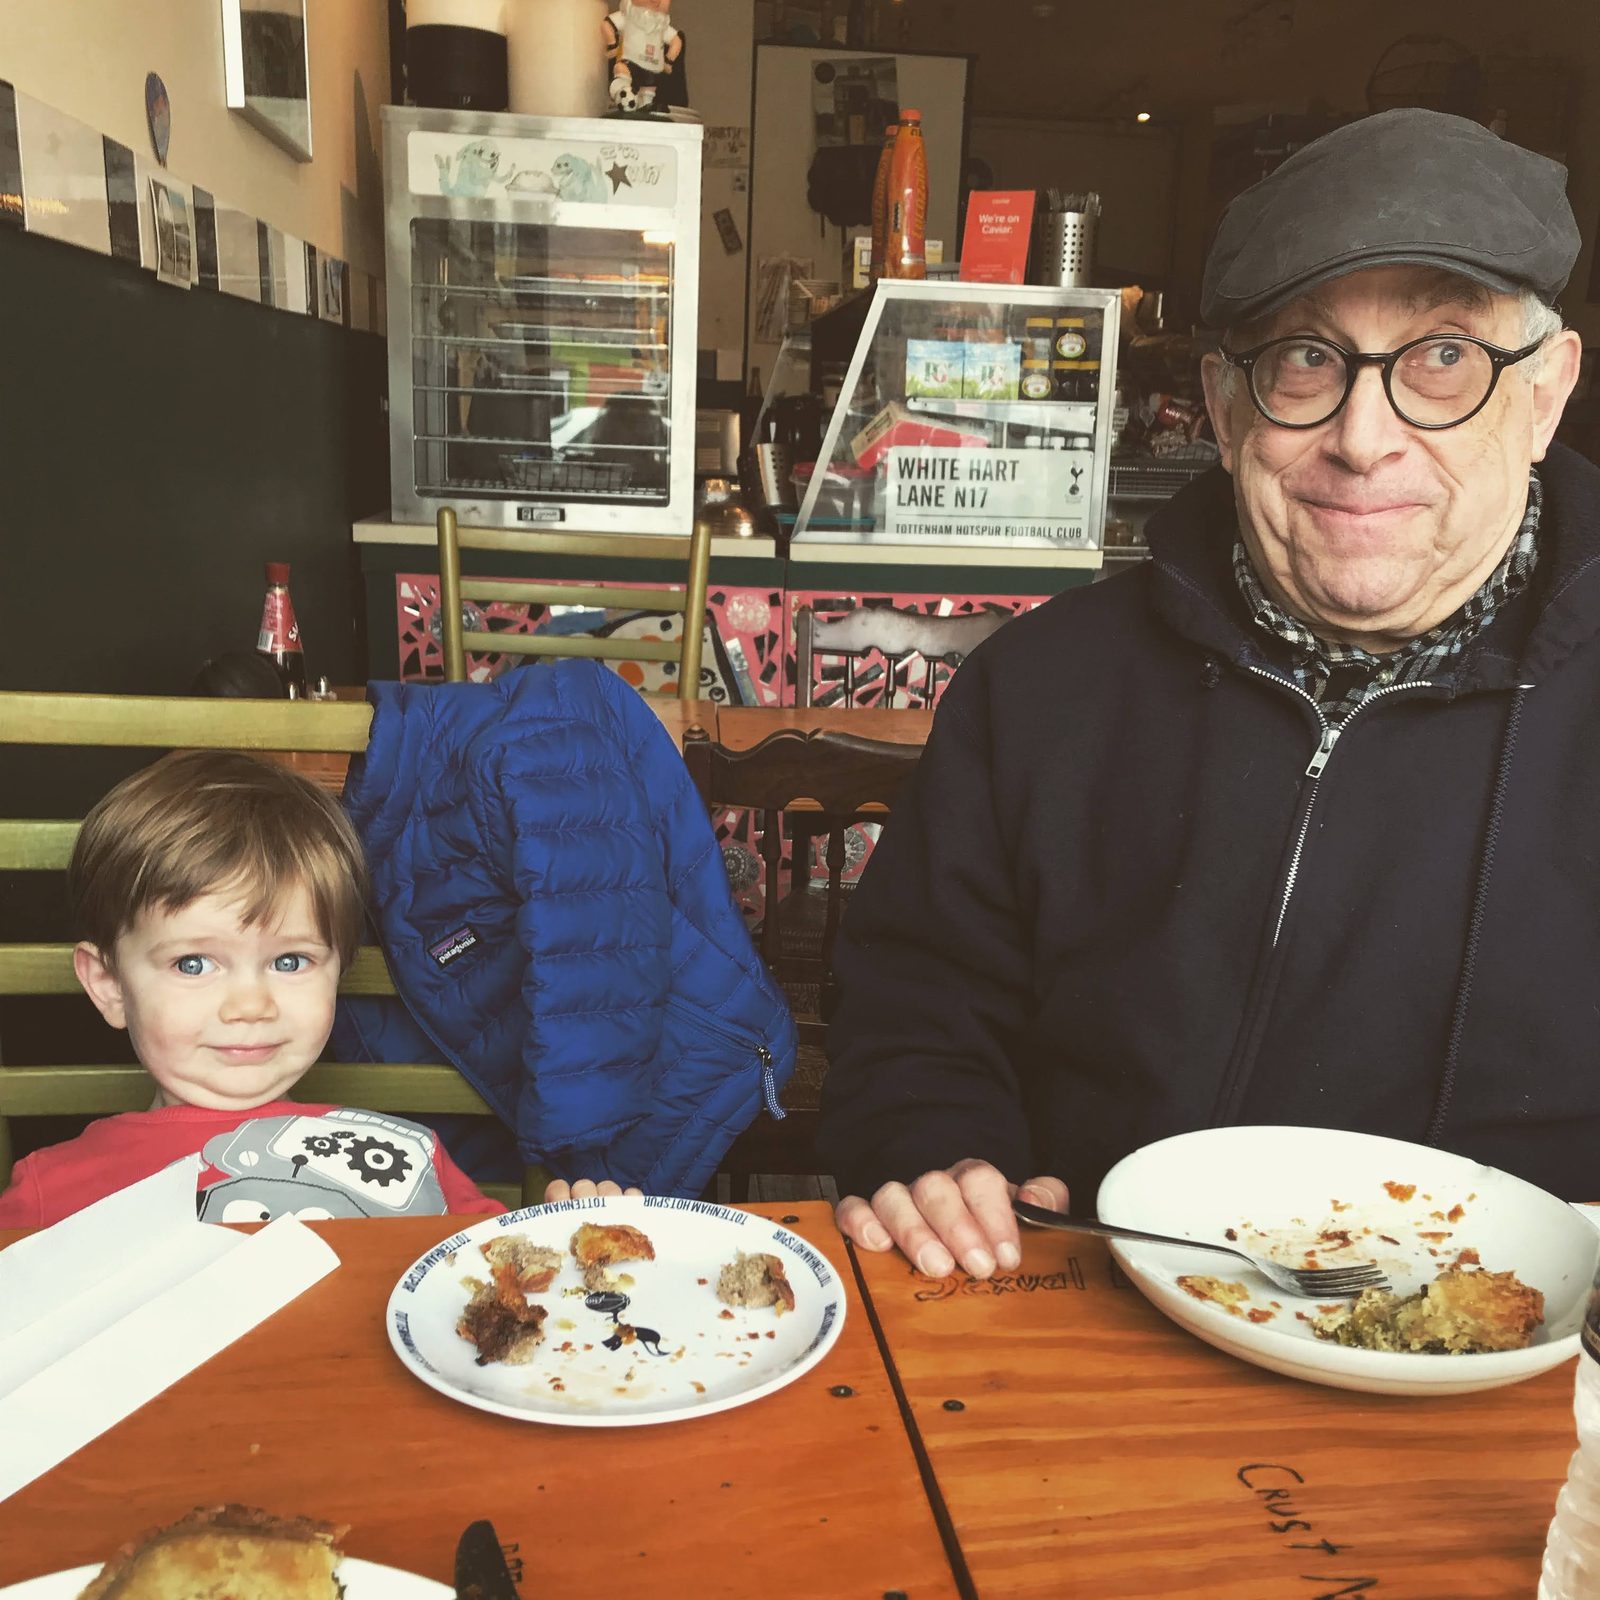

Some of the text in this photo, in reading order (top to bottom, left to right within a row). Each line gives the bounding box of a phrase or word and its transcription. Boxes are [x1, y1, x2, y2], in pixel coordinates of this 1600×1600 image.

[979, 214, 1020, 223] We're on
[898, 457, 1020, 482] WHITE HART
[897, 484, 989, 508] LANE N17
[896, 523, 1082, 538] TOTTENHAM HOTSPUR FOOTBALL CLUB
[438, 936, 477, 964] patagonia
[496, 1197, 606, 1226] TOTTENHAM HOTSPUR
[643, 1196, 749, 1225] TOTTENHAM HOTSPUR
